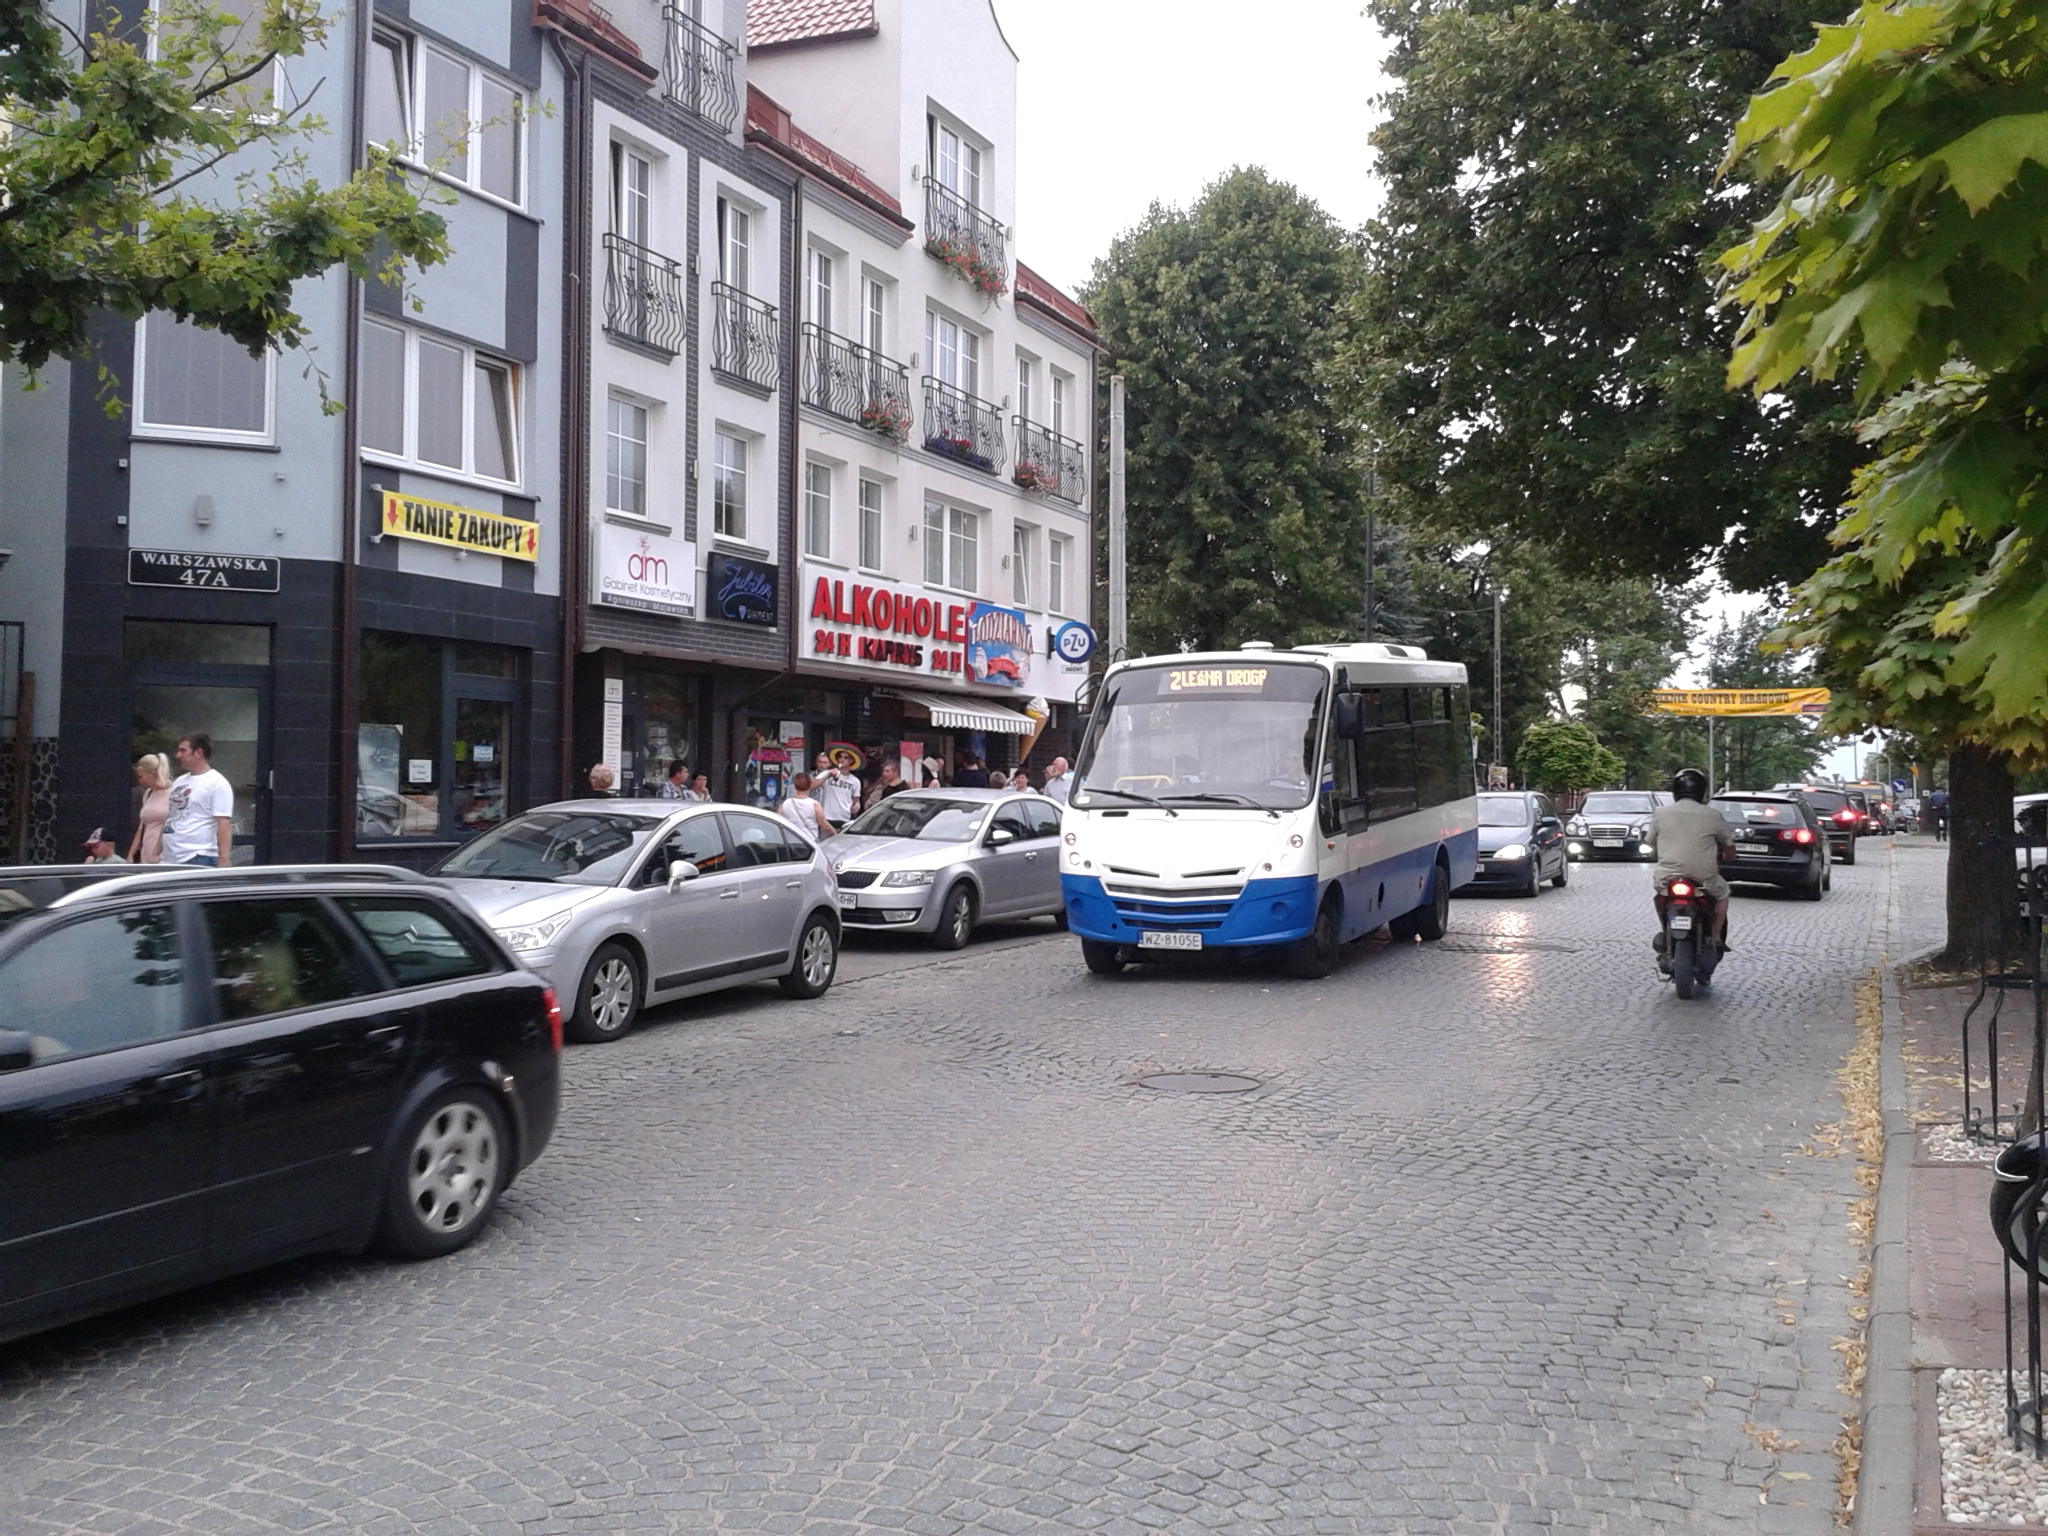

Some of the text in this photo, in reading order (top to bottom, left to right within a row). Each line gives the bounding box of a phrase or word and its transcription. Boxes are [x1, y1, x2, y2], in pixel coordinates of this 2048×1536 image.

[403, 501, 523, 553] TANIE ZAKUPY
[141, 552, 268, 571] WARSZAWSKA
[628, 553, 668, 585] am
[179, 569, 229, 587] 47A
[603, 576, 692, 604] Gabinet Kosmetyczny
[607, 595, 689, 615] Agnieszka Majewska
[811, 576, 966, 643] ALKOHOLE
[814, 629, 835, 654] 24
[837, 632, 852, 657] H
[932, 648, 948, 671] 24
[951, 651, 962, 673] H
[1063, 633, 1086, 652] PZU
[1170, 671, 1182, 691] 2
[1691, 692, 1736, 704] COUNTRY
